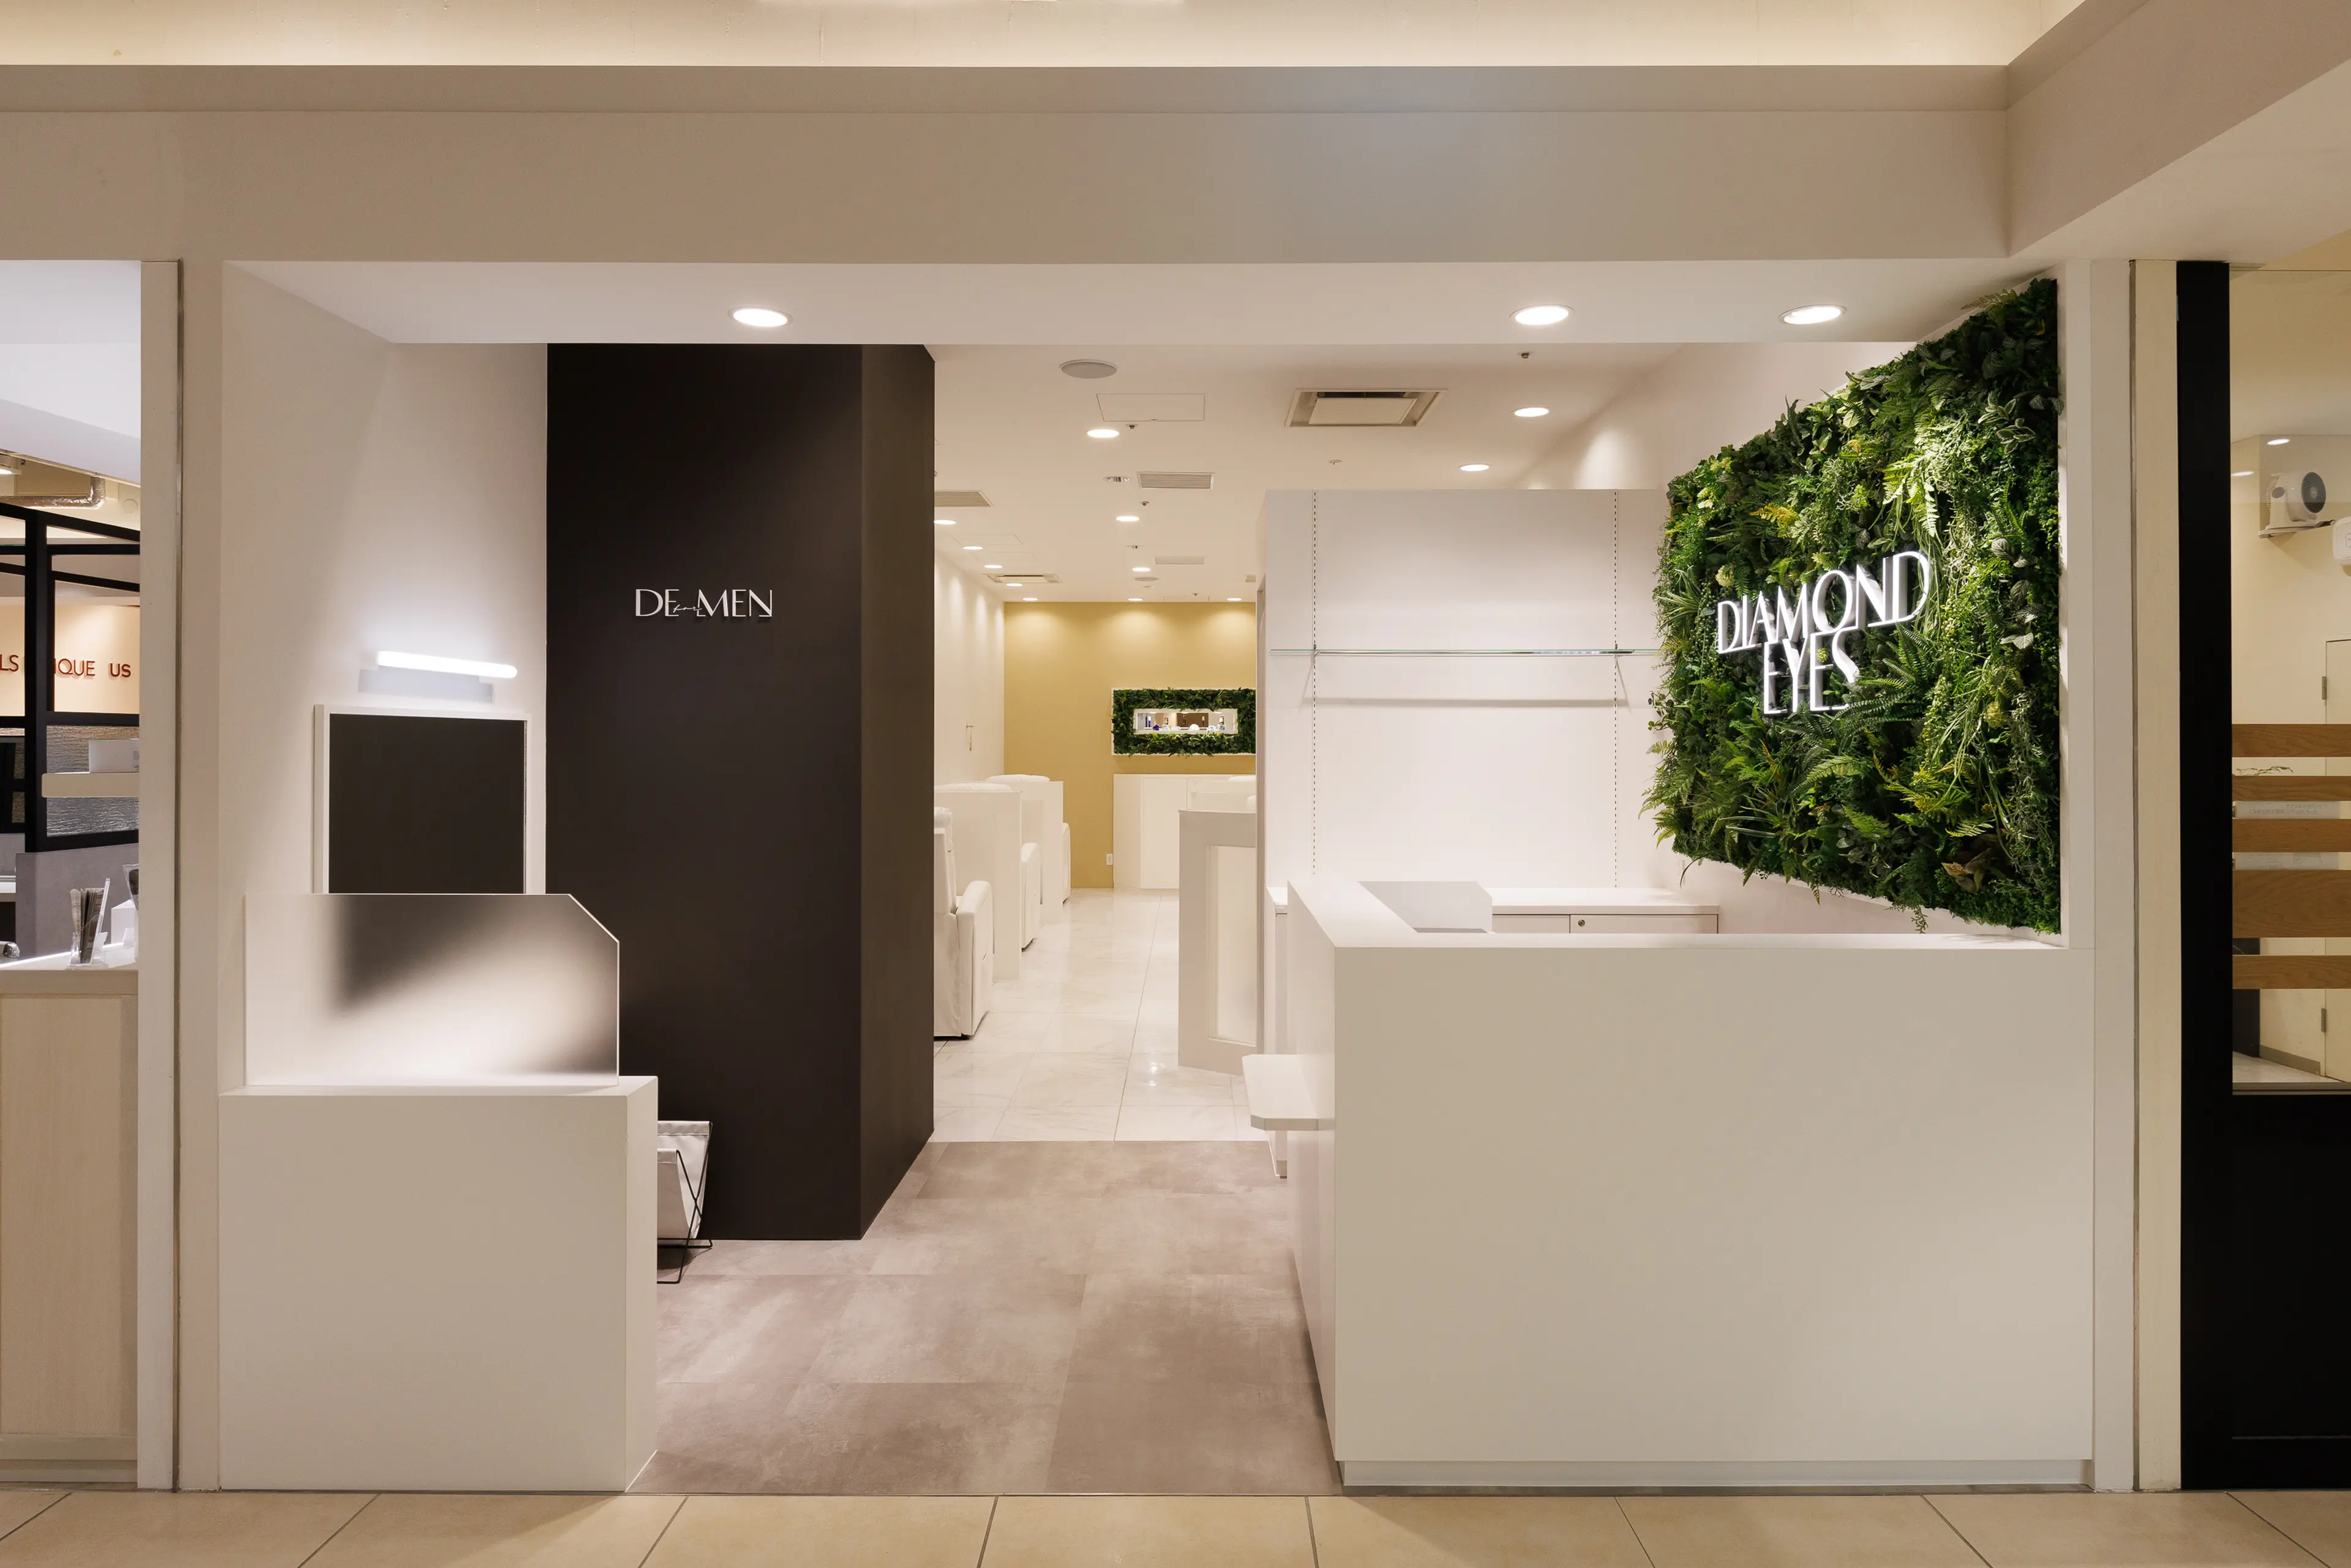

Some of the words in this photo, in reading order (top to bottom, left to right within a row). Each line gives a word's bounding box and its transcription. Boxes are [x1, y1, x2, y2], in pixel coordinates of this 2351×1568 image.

[635, 588, 680, 617] DE
[696, 588, 773, 617] MEN
[1717, 550, 1930, 654] DIAMOND
[110, 662, 132, 678] US
[1764, 626, 1860, 715] EYES
